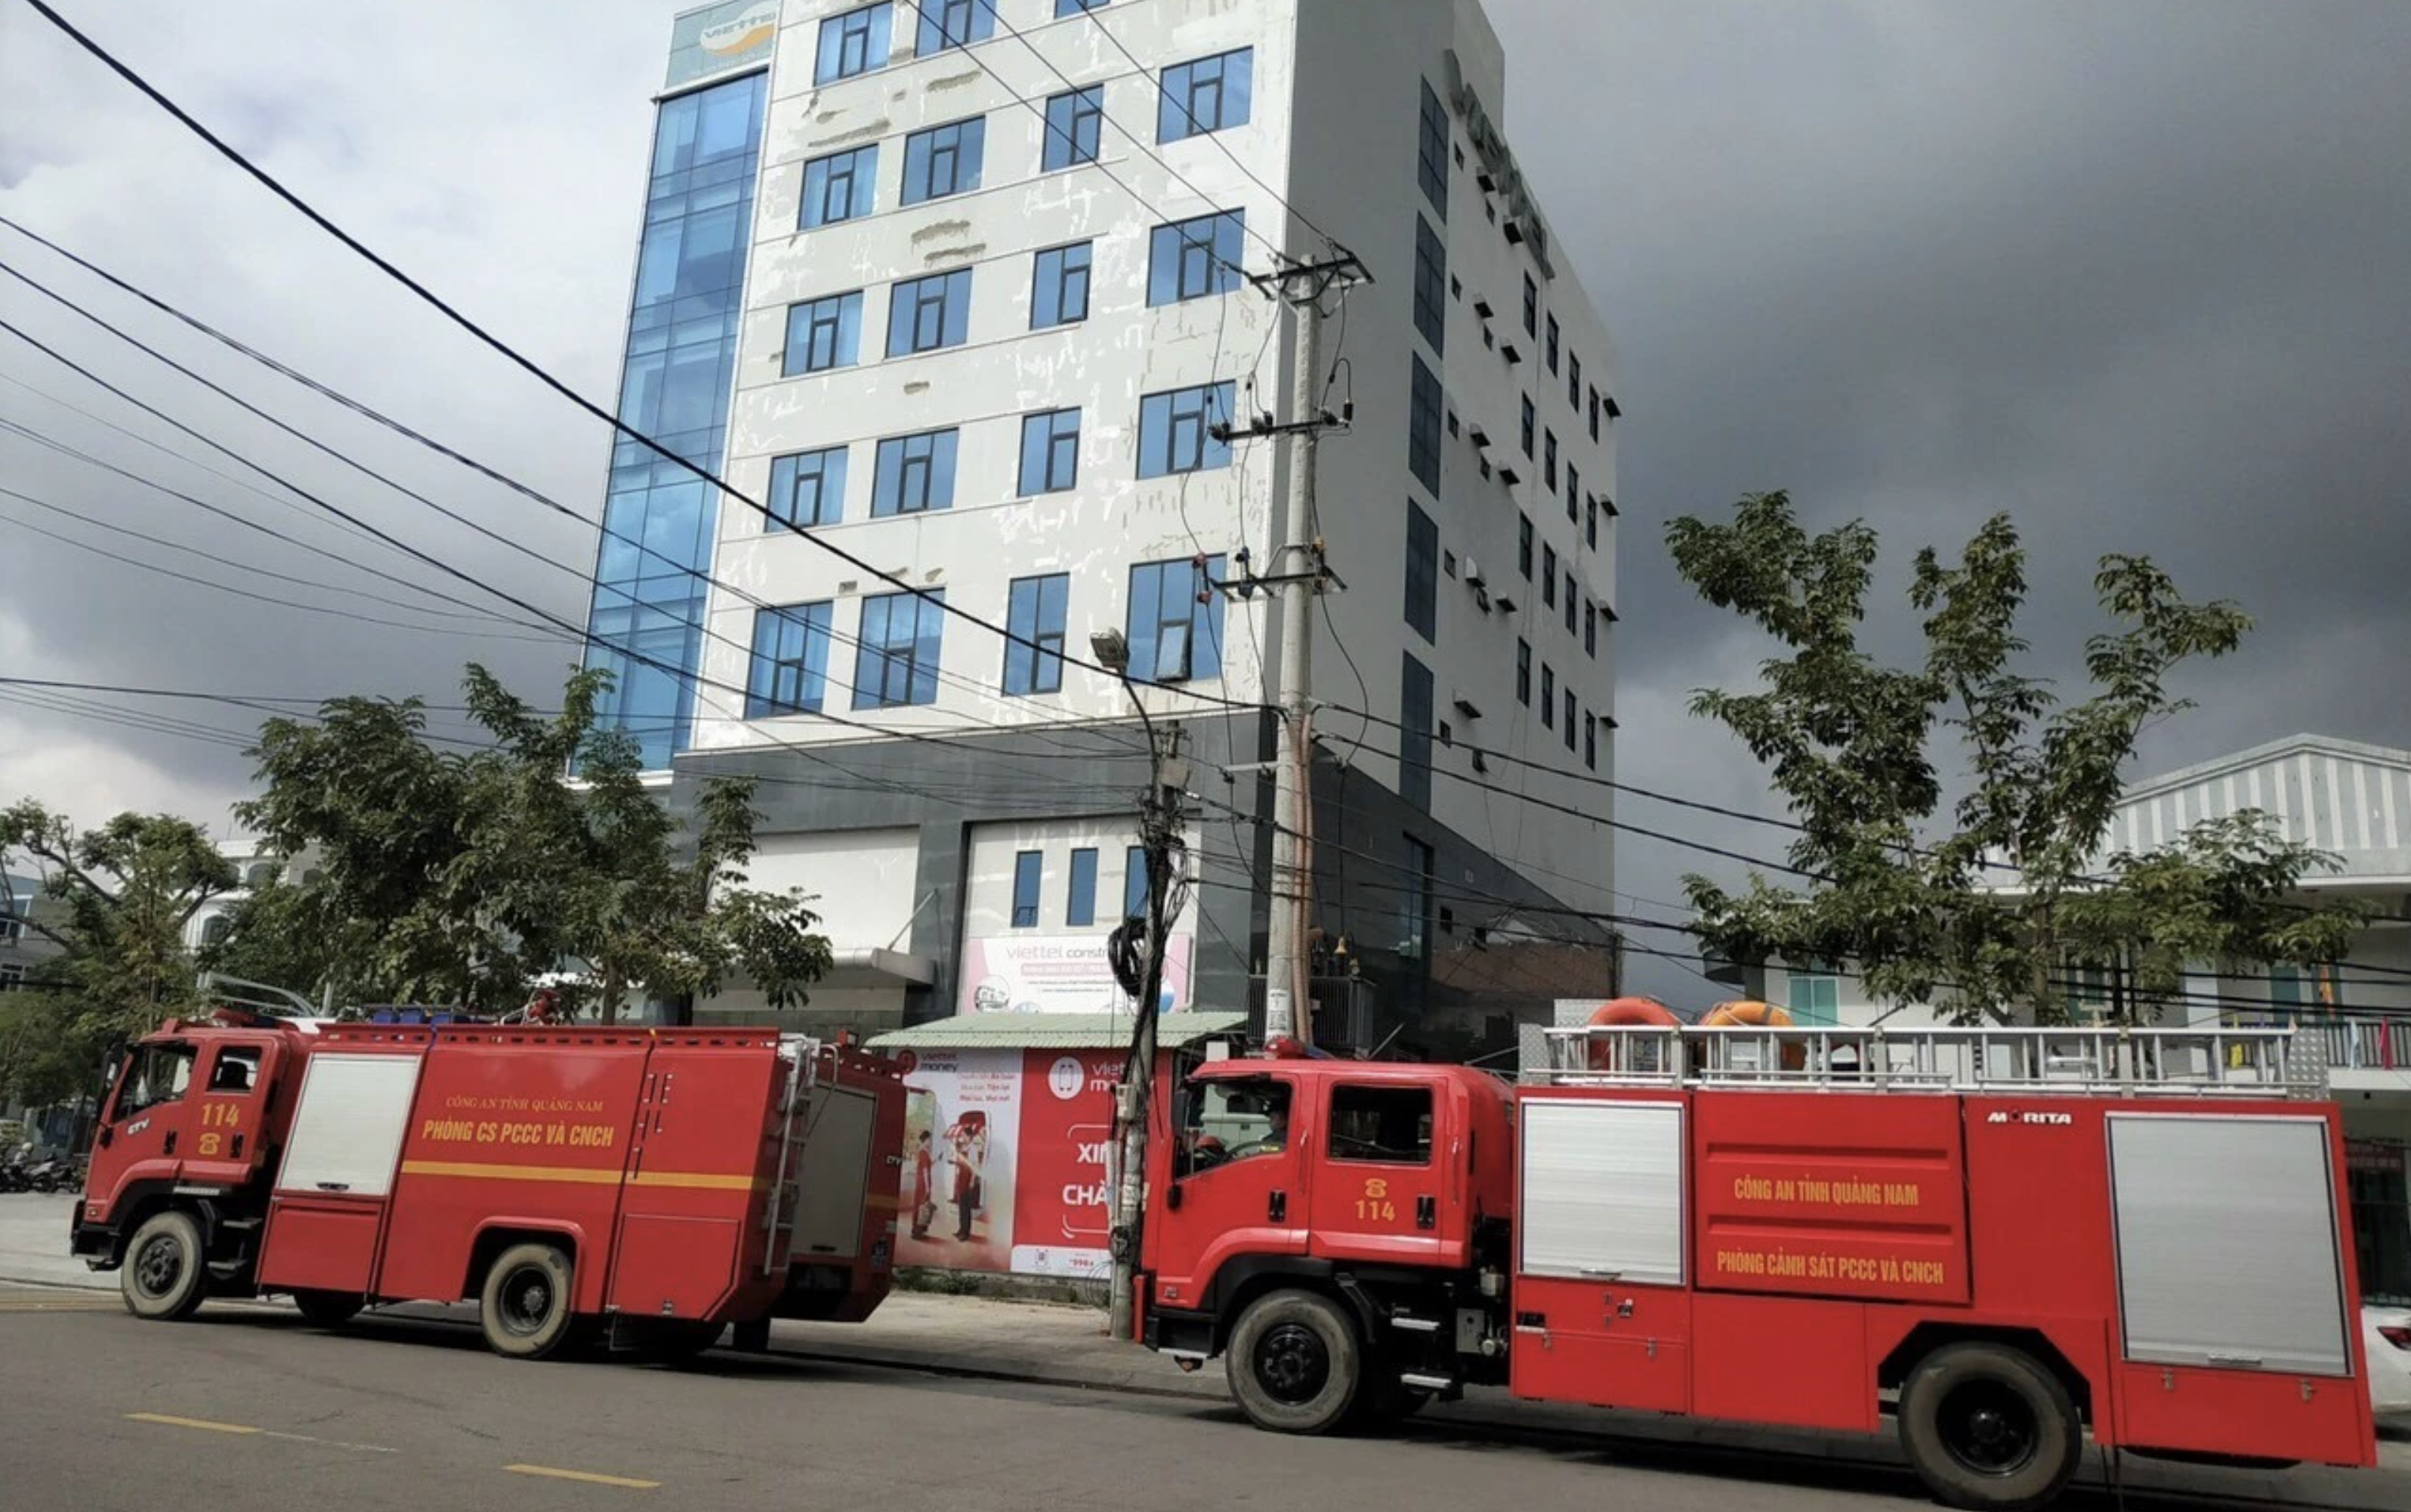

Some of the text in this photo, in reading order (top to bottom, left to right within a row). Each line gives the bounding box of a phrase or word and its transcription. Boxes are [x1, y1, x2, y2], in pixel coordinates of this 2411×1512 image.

[1006, 946, 1108, 959] viettel constr
[921, 1063, 959, 1072] money
[1092, 1062, 1125, 1075] viet
[202, 1103, 240, 1127] 114
[478, 1098, 497, 1109] AN
[575, 1100, 604, 1112] NAM
[477, 1122, 498, 1142] CS
[499, 1122, 542, 1143] PCCC
[569, 1125, 615, 1146] CNCH
[1735, 1174, 1772, 1200] CÔNG
[1775, 1180, 1795, 1201] AN
[1832, 1174, 1882, 1205] QUẢNG
[1884, 1183, 1919, 1205] NAM
[1355, 1200, 1396, 1220] 114
[1717, 1247, 1944, 1285] PHÒNG CẢNH SÁT PCCC VÀ CNCH
